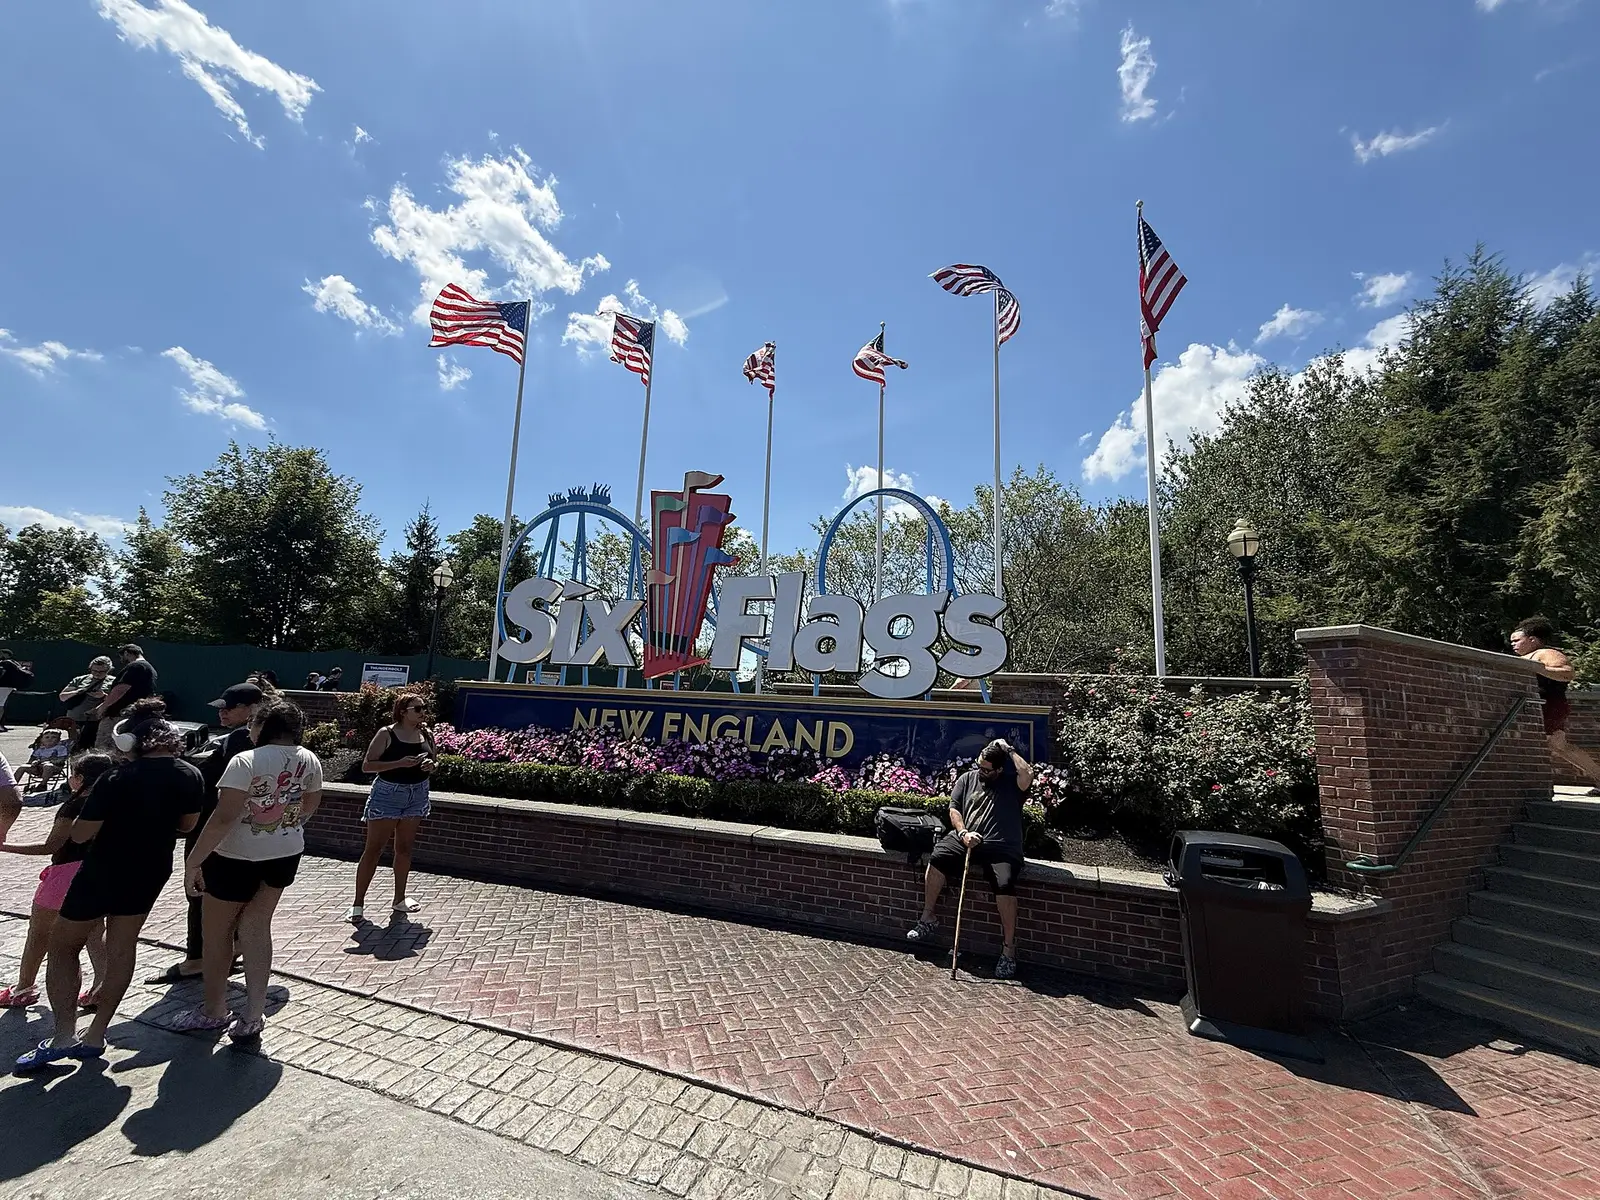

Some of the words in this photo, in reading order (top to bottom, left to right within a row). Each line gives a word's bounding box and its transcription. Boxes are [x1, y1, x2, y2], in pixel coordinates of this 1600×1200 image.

[498, 577, 647, 668] Six
[710, 571, 1008, 699] Flags
[661, 712, 855, 758] ENGLAND
